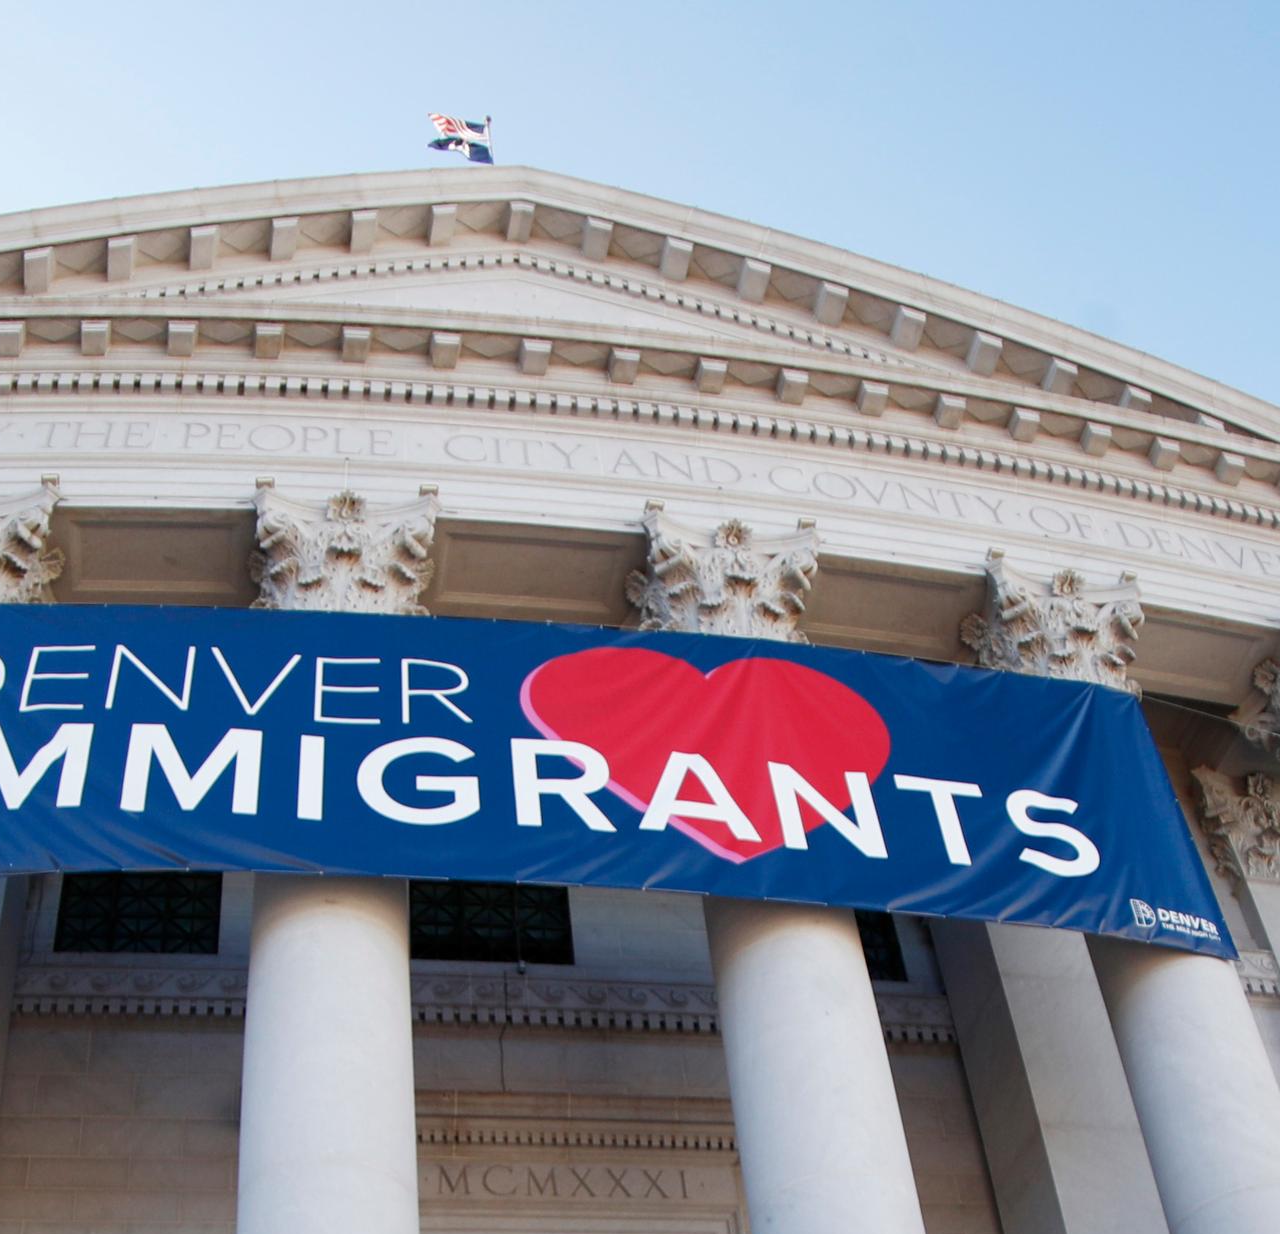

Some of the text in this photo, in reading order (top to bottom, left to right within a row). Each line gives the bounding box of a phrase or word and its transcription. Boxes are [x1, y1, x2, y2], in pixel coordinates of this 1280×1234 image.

[34, 420, 155, 450] THE
[181, 421, 399, 456] PEOPLE
[443, 434, 584, 470] CITY
[612, 449, 742, 485] AND
[768, 465, 1006, 525] COVNTY
[1028, 505, 1097, 539] OF
[1157, 908, 1219, 935] DENVER
[437, 1164, 689, 1199] MCMXXXI
